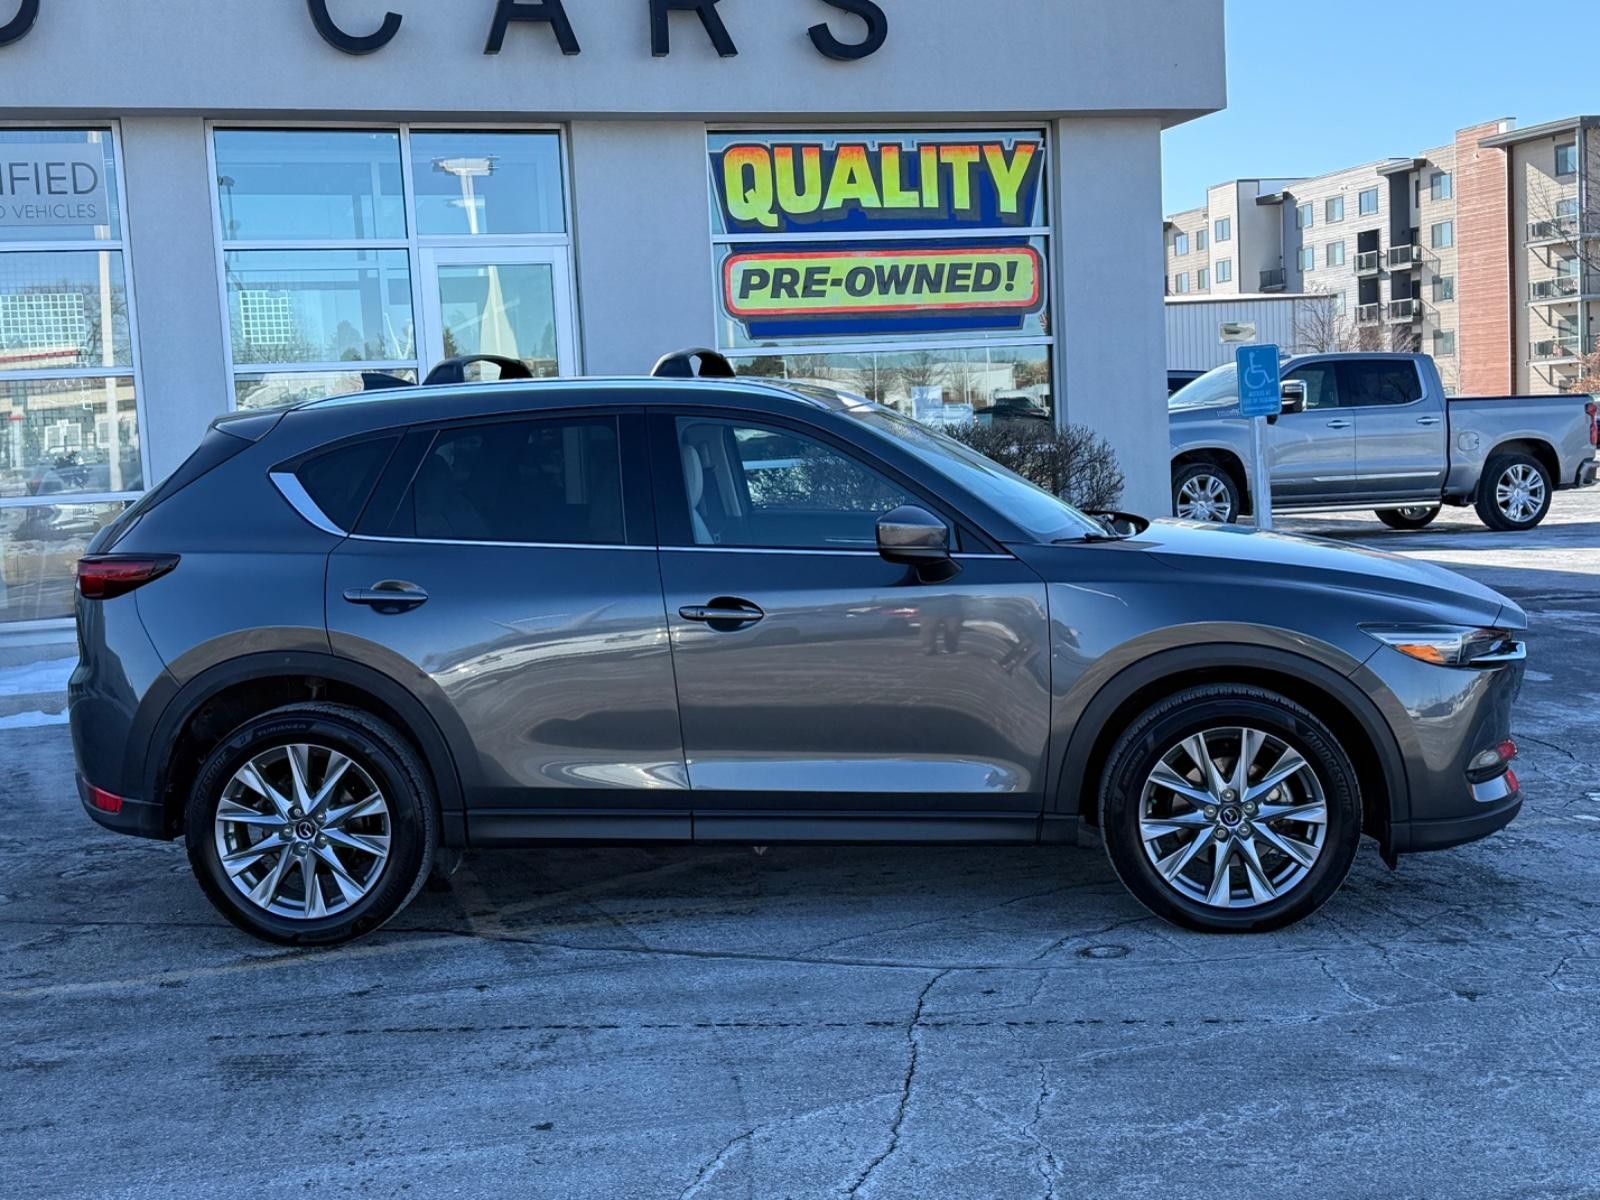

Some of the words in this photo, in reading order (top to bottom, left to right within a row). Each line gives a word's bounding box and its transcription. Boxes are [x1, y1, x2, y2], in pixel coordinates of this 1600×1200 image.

[723, 144, 1036, 228] QUALITY
[12, 204, 97, 219] VEHICLES
[738, 260, 1019, 300] PRE-OWNED!
